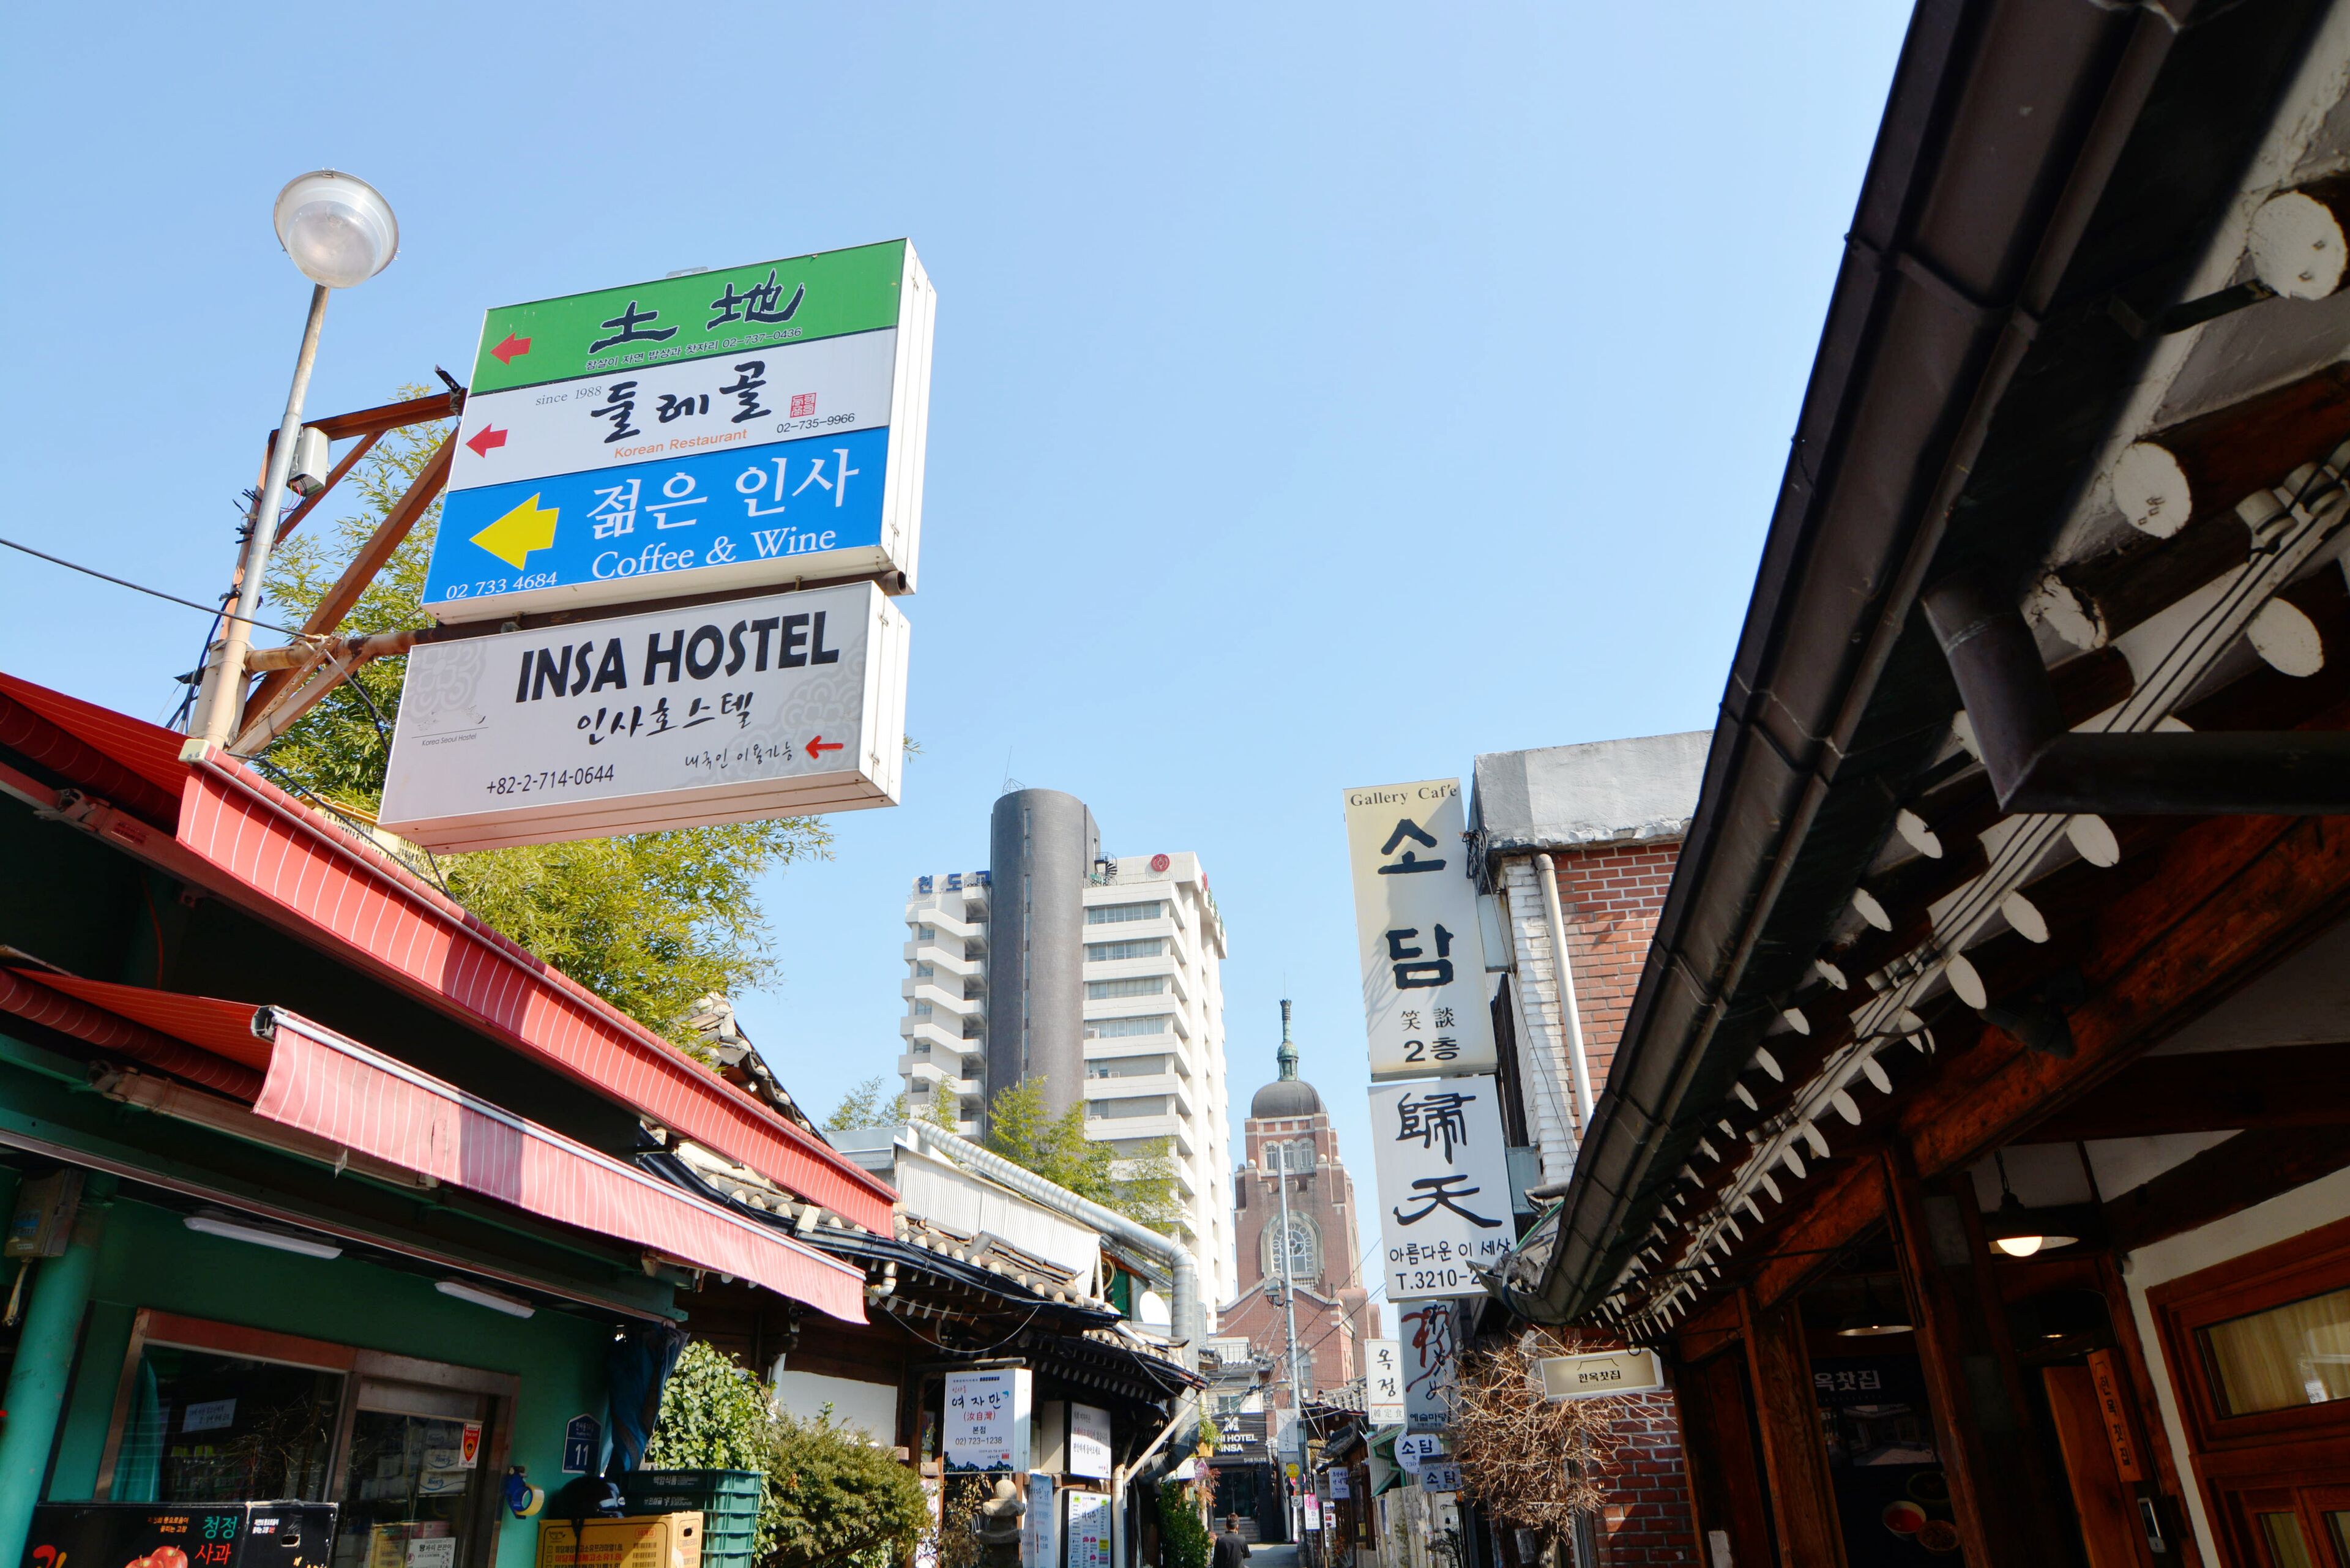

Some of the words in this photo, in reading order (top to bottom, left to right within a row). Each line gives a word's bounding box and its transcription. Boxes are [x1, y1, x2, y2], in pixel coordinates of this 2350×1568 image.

[588, 268, 805, 355] 土地
[586, 356, 617, 370] 참살이
[622, 353, 644, 364] 자연
[648, 346, 681, 360] 밥상과
[685, 340, 718, 354] 찻자리
[722, 327, 802, 348] 02-737-0436
[535, 391, 568, 406] since
[575, 384, 602, 400] 1988
[776, 413, 856, 434] 02-735-9966
[614, 442, 665, 459] Korean
[669, 429, 748, 450] Restaurant
[586, 471, 709, 540] 젊은
[735, 447, 860, 519] 인사
[591, 542, 695, 580] Coffee
[706, 535, 737, 562] &
[751, 525, 836, 559] Wine
[446, 583, 469, 600] 02
[475, 577, 507, 597] 733
[512, 570, 558, 591] 4684
[515, 637, 627, 704] INSA
[643, 610, 840, 687] HOSTEL
[440, 736, 457, 744] Seoul
[458, 733, 477, 742] Hostel
[487, 763, 615, 796] +82-2-714-0644
[1349, 791, 1408, 807] Gallery
[1389, 1240, 1452, 1266] 아름다운
[1458, 1242, 1472, 1257] 이
[1578, 1370, 1621, 1383] 한옥찻집
[1813, 1369, 1881, 1392] 옥찻집
[951, 1391, 1001, 1409] 여자만
[1409, 1413, 1447, 1422] 예술마당
[968, 1436, 1002, 1445] 723-1238
[972, 1425, 987, 1435] 본점
[1226, 1433, 1258, 1443] HOTEL
[575, 1443, 589, 1466] 11
[1220, 1443, 1244, 1452] INSA
[202, 1515, 238, 1539] 청정
[194, 1543, 232, 1566] 사과
